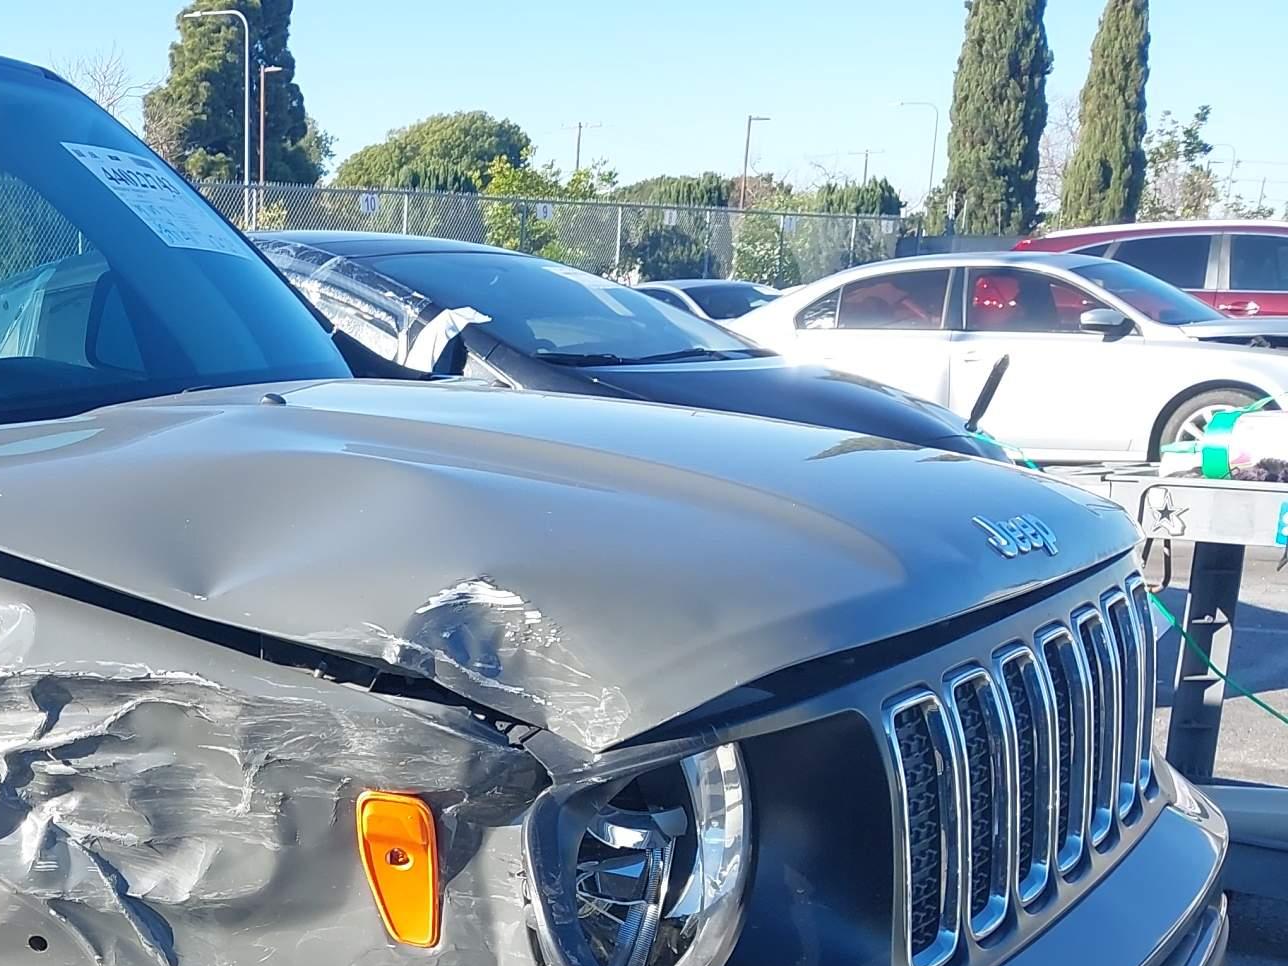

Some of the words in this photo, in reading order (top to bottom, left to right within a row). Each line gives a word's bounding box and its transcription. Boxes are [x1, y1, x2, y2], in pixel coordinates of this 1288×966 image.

[101, 167, 181, 195] 44022743
[364, 195, 376, 212] 10
[542, 205, 548, 219] 9
[970, 514, 1059, 558] Jeep
